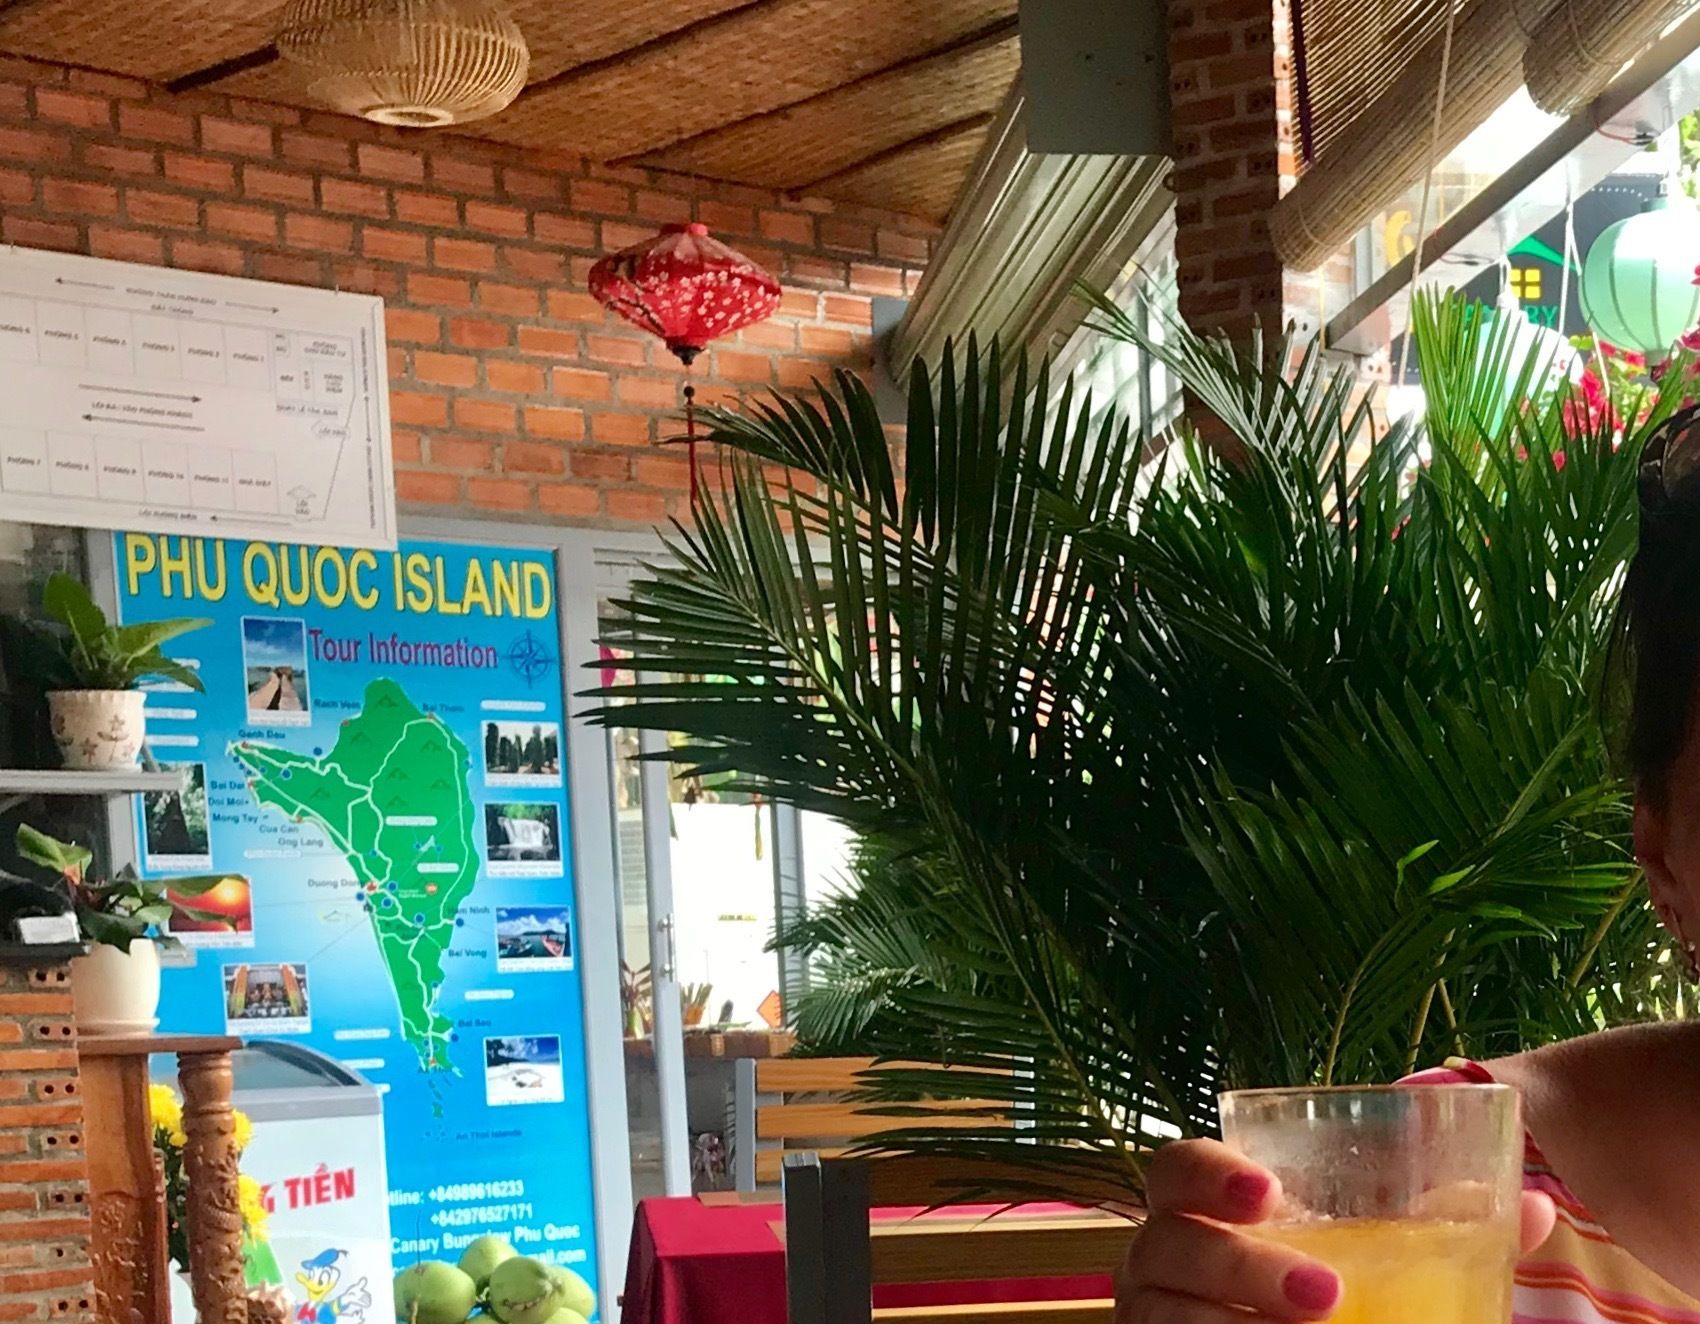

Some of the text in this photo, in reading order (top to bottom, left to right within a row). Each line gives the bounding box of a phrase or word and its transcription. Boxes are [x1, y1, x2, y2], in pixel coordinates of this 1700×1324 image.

[125, 534, 552, 620] PHU QUOC ISLAND
[308, 627, 498, 669] Tour Information
[392, 1234, 440, 1255] Canary
[514, 1226, 542, 1243] Phu
